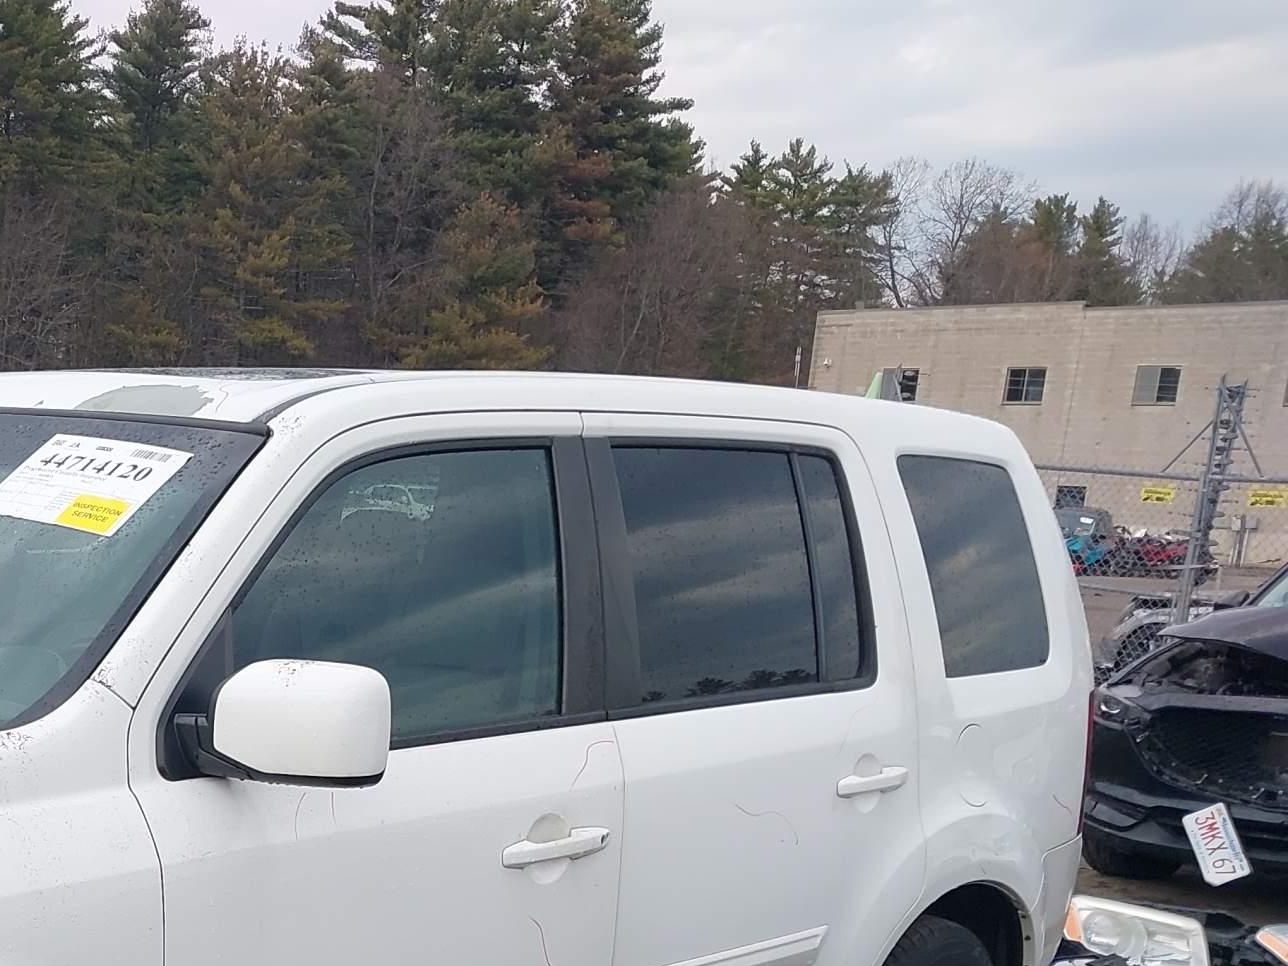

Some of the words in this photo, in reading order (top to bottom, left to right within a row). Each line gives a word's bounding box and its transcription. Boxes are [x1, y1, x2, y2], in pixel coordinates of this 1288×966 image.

[40, 453, 153, 482] 44714120
[72, 510, 109, 523] SERVICE
[73, 502, 123, 516] INSPECTION
[1194, 811, 1229, 856] 3MKX
[1212, 858, 1237, 874] 67
